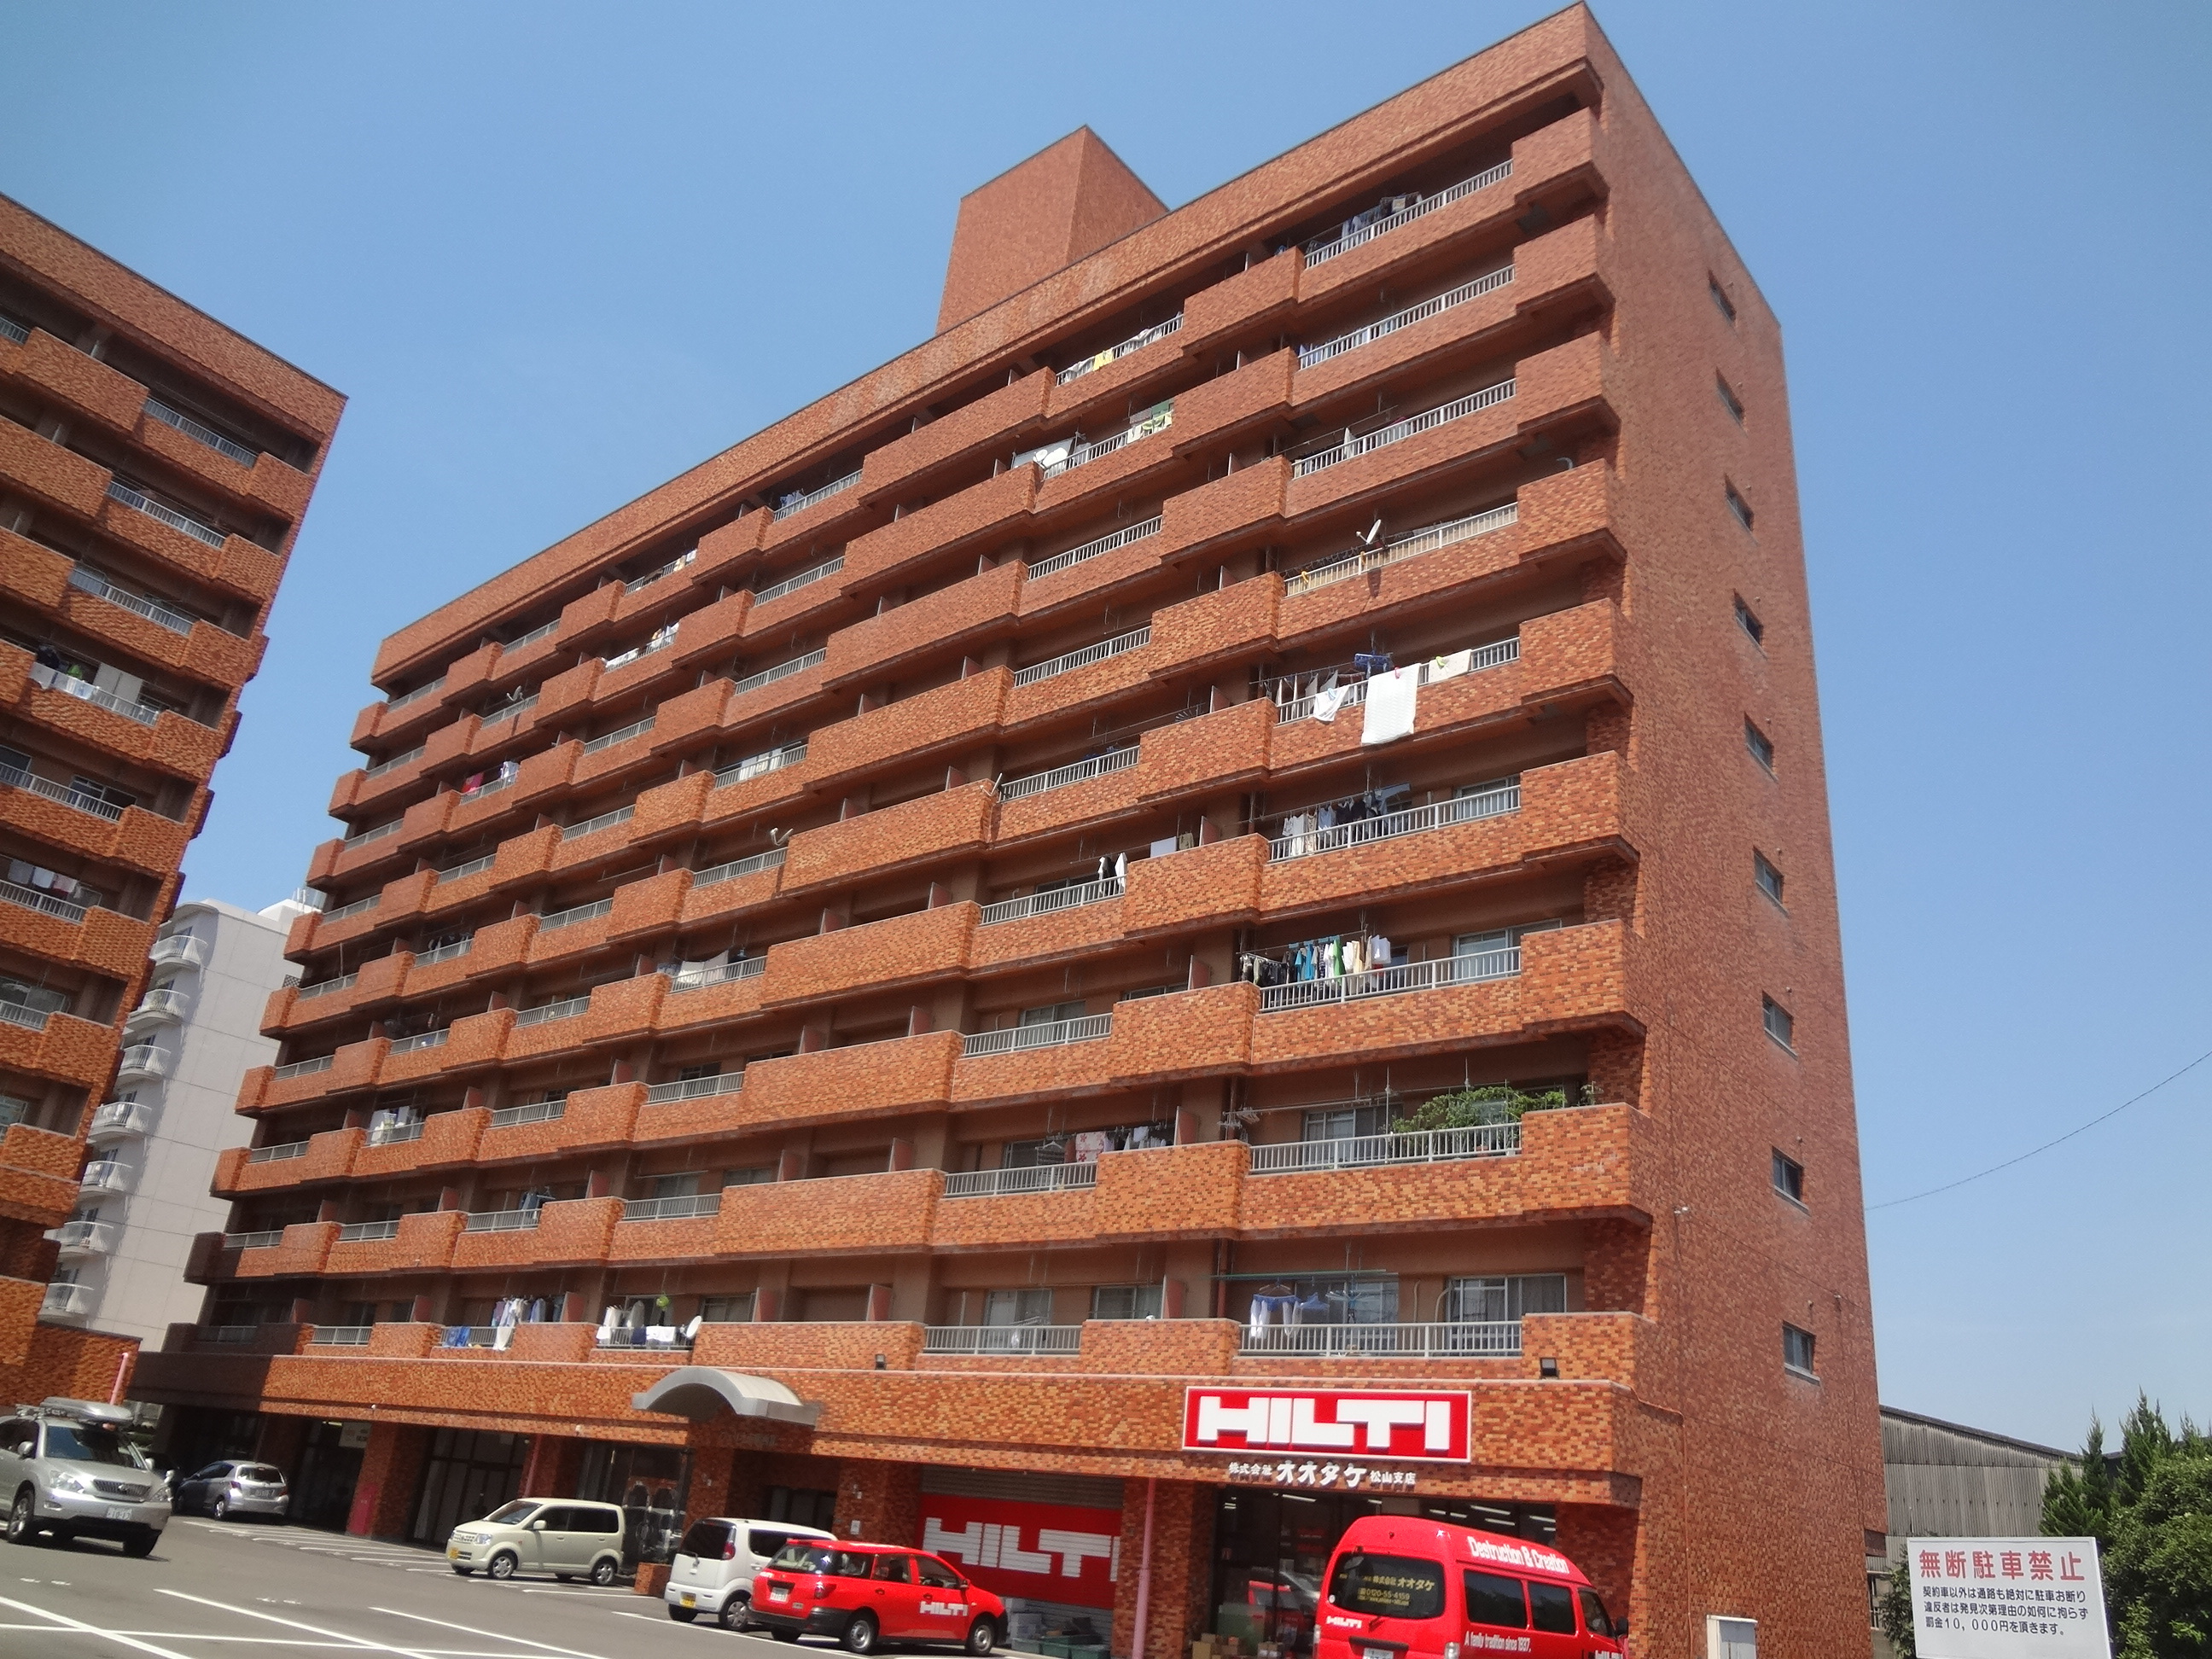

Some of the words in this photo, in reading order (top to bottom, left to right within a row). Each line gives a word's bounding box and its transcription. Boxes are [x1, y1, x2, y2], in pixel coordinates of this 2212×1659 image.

[1196, 1395, 1452, 1452] HILTI
[1228, 1461, 1272, 1477] 株式会社
[1275, 1459, 1367, 1487] オオタケ
[1369, 1470, 1417, 1486] 松山支店
[1467, 1535, 1524, 1565] Destruction
[1521, 1545, 1534, 1568] &
[1531, 1549, 1570, 1574] Creation
[1918, 1549, 2086, 1581] 無断駐車禁止
[1397, 1577, 1435, 1592] オオタケ
[1923, 1586, 2087, 1603] 契約車以外は通路も絶対に駐車お断り
[919, 1600, 969, 1616] HILTI
[1924, 1601, 2089, 1620] 違反者は発見次第理由の如何に拘らず
[1325, 1615, 1363, 1628] HILTI
[1464, 1630, 1470, 1646] A
[1484, 1633, 1505, 1650] tradition
[1505, 1635, 1518, 1651] since
